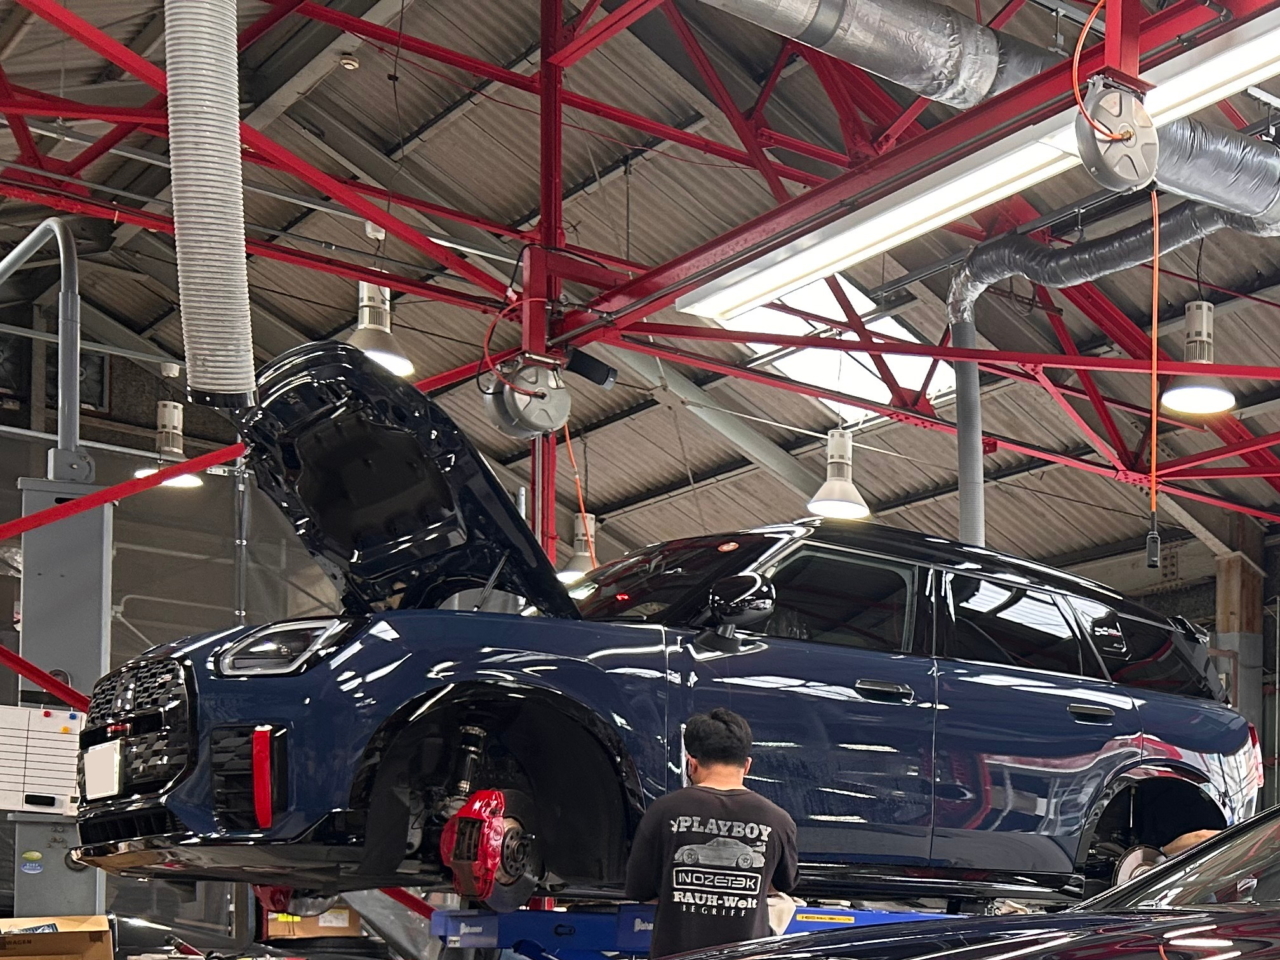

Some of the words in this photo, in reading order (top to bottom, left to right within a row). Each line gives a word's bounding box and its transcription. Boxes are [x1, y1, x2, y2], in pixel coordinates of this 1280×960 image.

[679, 816, 772, 841] PLAYBOY
[673, 891, 758, 908] RAUH-Welt
[682, 904, 746, 917] BEGRIFF
